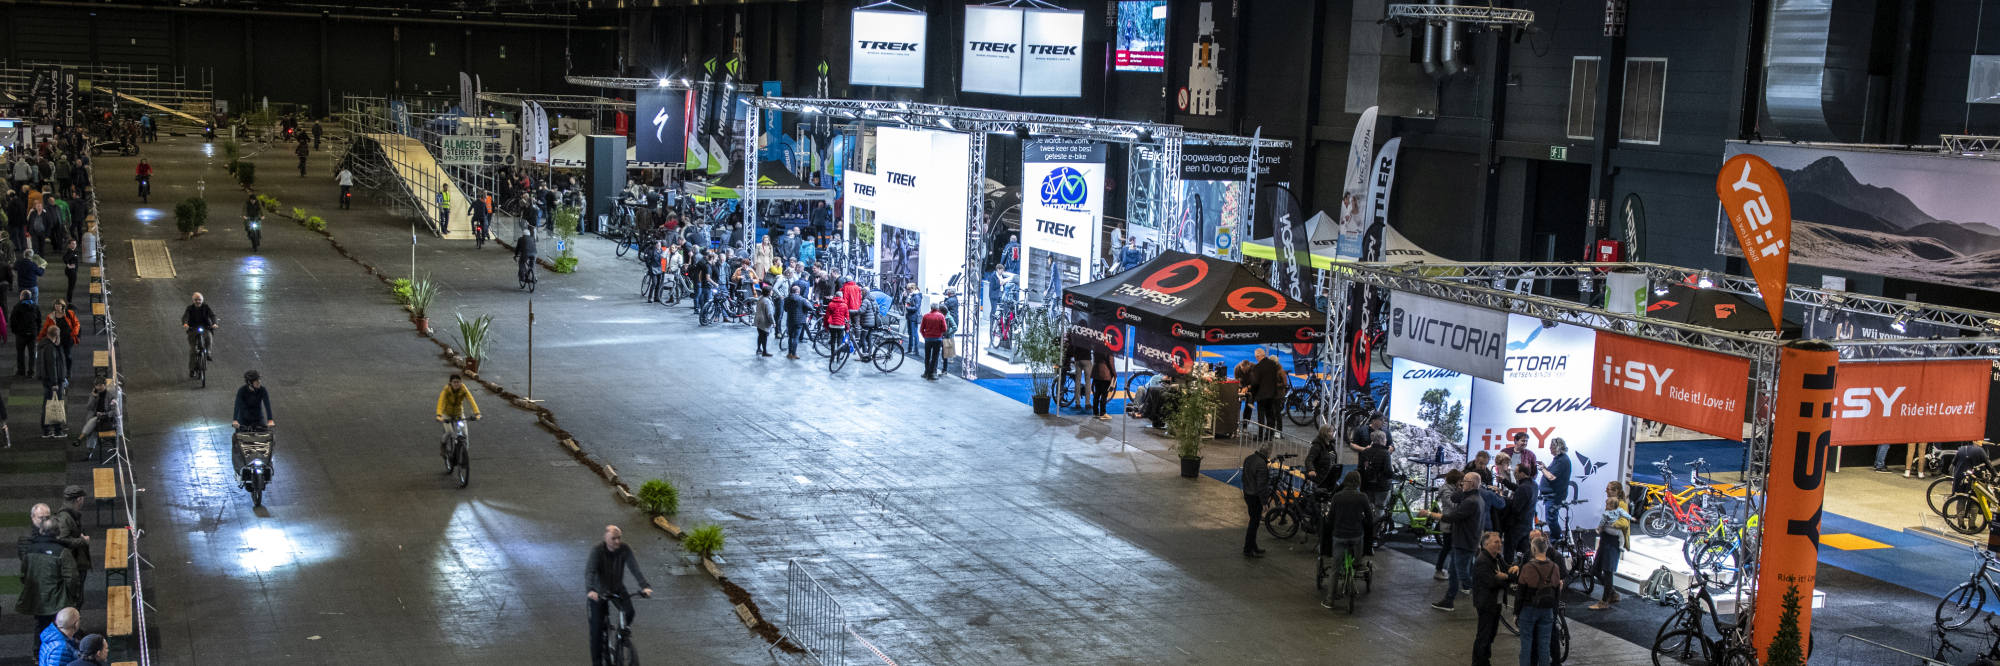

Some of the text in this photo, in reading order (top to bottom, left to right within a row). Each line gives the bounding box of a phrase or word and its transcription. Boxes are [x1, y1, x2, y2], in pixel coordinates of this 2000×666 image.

[858, 40, 919, 52] TREK
[969, 41, 1017, 54] TREK
[1028, 44, 1078, 56] TREK
[65, 73, 74, 127] SANTOS
[1162, 86, 1166, 98] 5
[697, 73, 711, 134] MERIDA
[717, 73, 733, 137] MERIDA
[444, 140, 482, 150] ALMECO
[1045, 153, 1067, 161] geteste
[1181, 154, 1281, 164] oogwaardig gebod met
[1185, 165, 1200, 173] een
[1201, 164, 1210, 172] 10
[1211, 165, 1229, 173] voor
[886, 170, 917, 188] TREK
[1374, 156, 1393, 222] TTLER
[1035, 218, 1077, 240] TREK
[1385, 248, 1426, 256] ETTLER
[1115, 283, 1187, 307] THOMPSON
[1220, 311, 1311, 319] THOMPSON
[1216, 332, 1260, 340] THOMPSON
[1409, 313, 1501, 360] VICTORIA
[1505, 355, 1567, 371] CTORIA
[1603, 355, 1736, 412] i:SY Ride it! Love it!
[1515, 397, 1603, 414] CONWA
[1831, 386, 1976, 419] :SY Ride it! Love it!
[1481, 426, 1556, 451] i:SY
